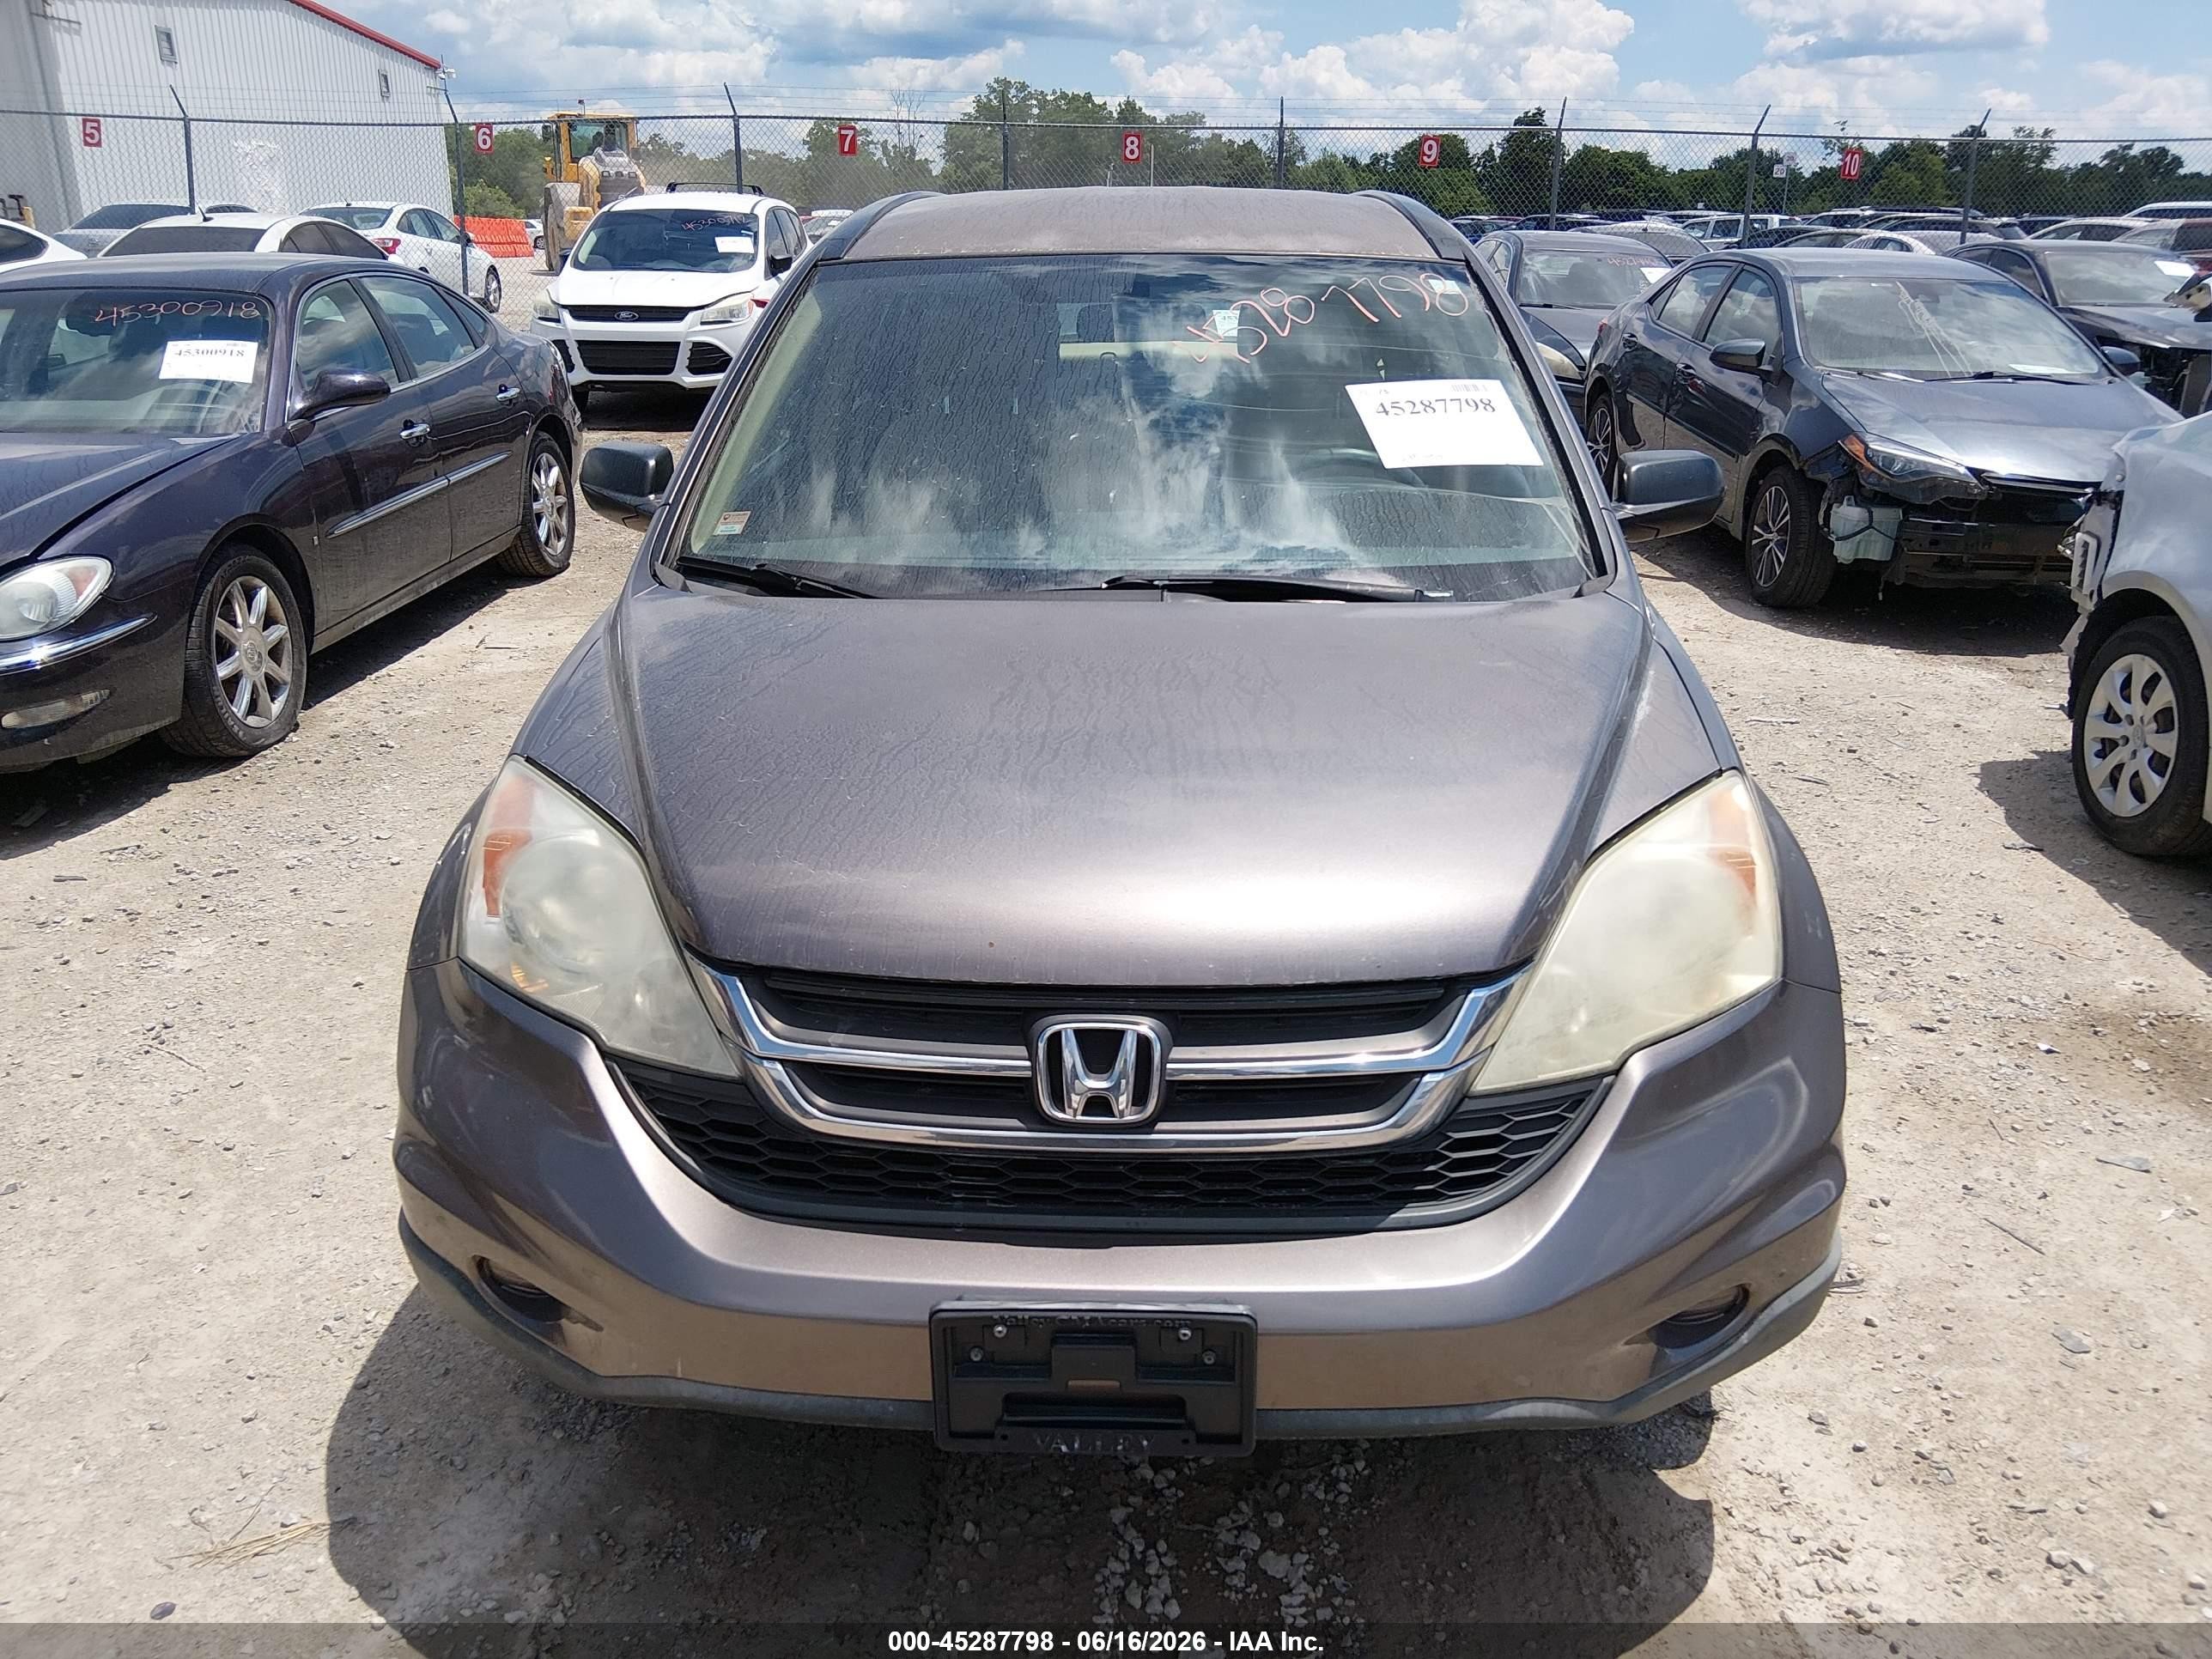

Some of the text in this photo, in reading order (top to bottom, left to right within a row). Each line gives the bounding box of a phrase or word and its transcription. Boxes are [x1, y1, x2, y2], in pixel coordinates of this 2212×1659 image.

[85, 121, 100, 144] 5
[477, 127, 491, 149] 6
[840, 129, 854, 152] 7
[1125, 136, 1139, 160] 8
[1422, 139, 1437, 163] 9
[1844, 153, 1860, 176] 10
[94, 300, 260, 326] 45300918
[174, 348, 246, 357] 45300918
[1376, 398, 1497, 416] 45287798
